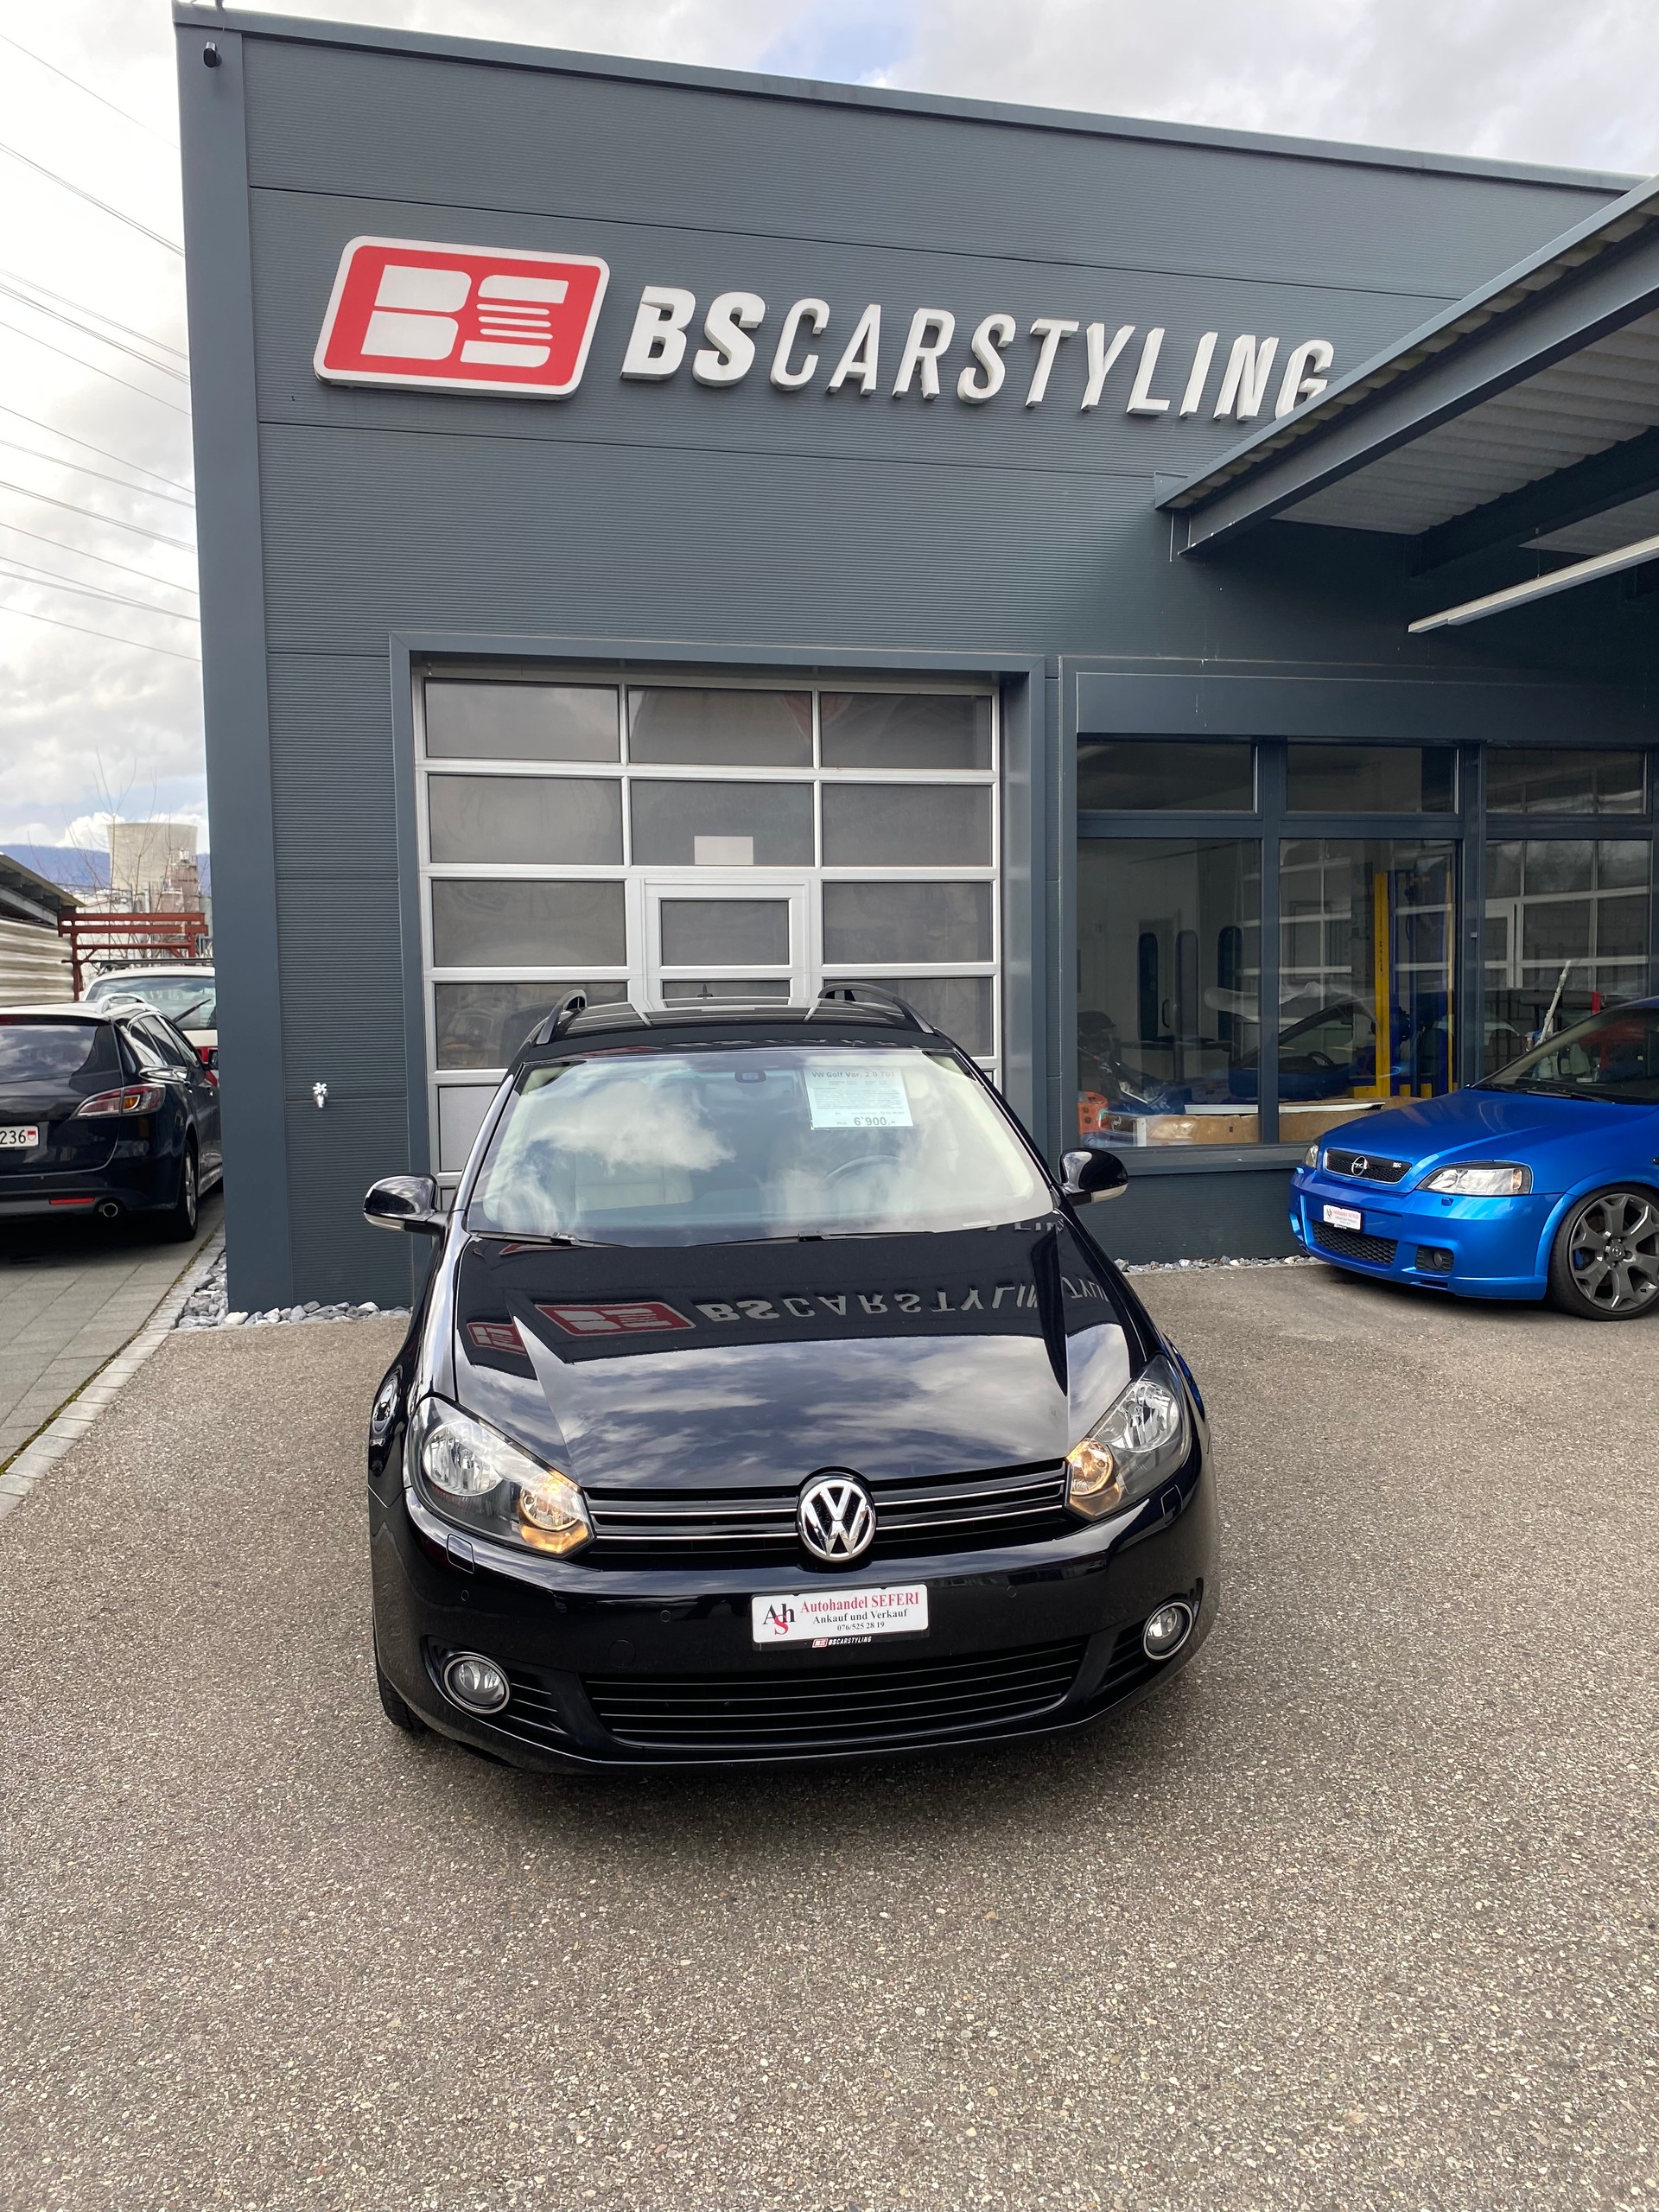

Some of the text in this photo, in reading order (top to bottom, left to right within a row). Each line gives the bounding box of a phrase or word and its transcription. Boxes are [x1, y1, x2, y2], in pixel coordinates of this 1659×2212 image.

[800, 1592, 919, 1613] Autohandel SEFERI
[812, 1608, 908, 1624] Ankauf und Verkauf
[836, 1623, 865, 1631] 076/525
